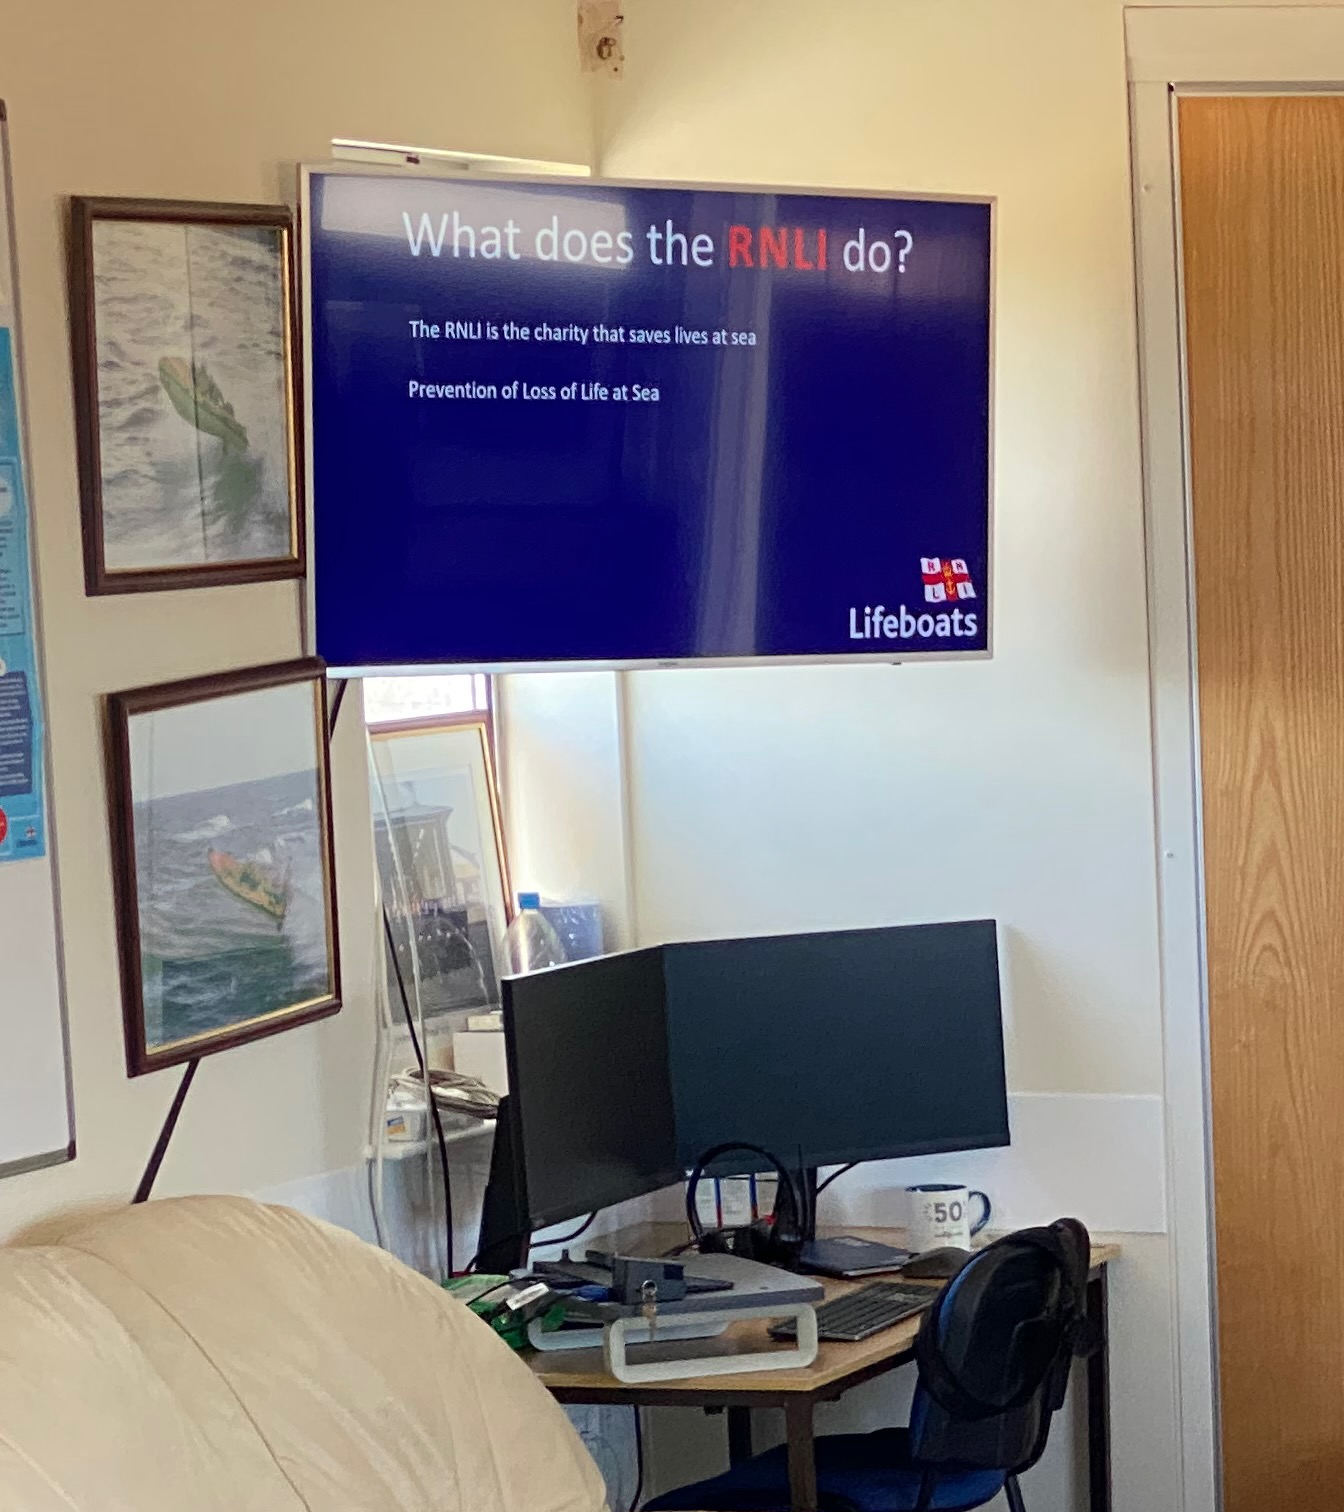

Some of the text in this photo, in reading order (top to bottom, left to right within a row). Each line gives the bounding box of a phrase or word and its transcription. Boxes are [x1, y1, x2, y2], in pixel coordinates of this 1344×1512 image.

[403, 211, 914, 273] What does the RNLI do?
[408, 320, 757, 346] The RNLI is the charity that saves lives at sea
[408, 380, 661, 402] Prevention of Loss of Life at Sea
[849, 604, 978, 639] Lifeboats
[933, 1200, 963, 1224] 50
